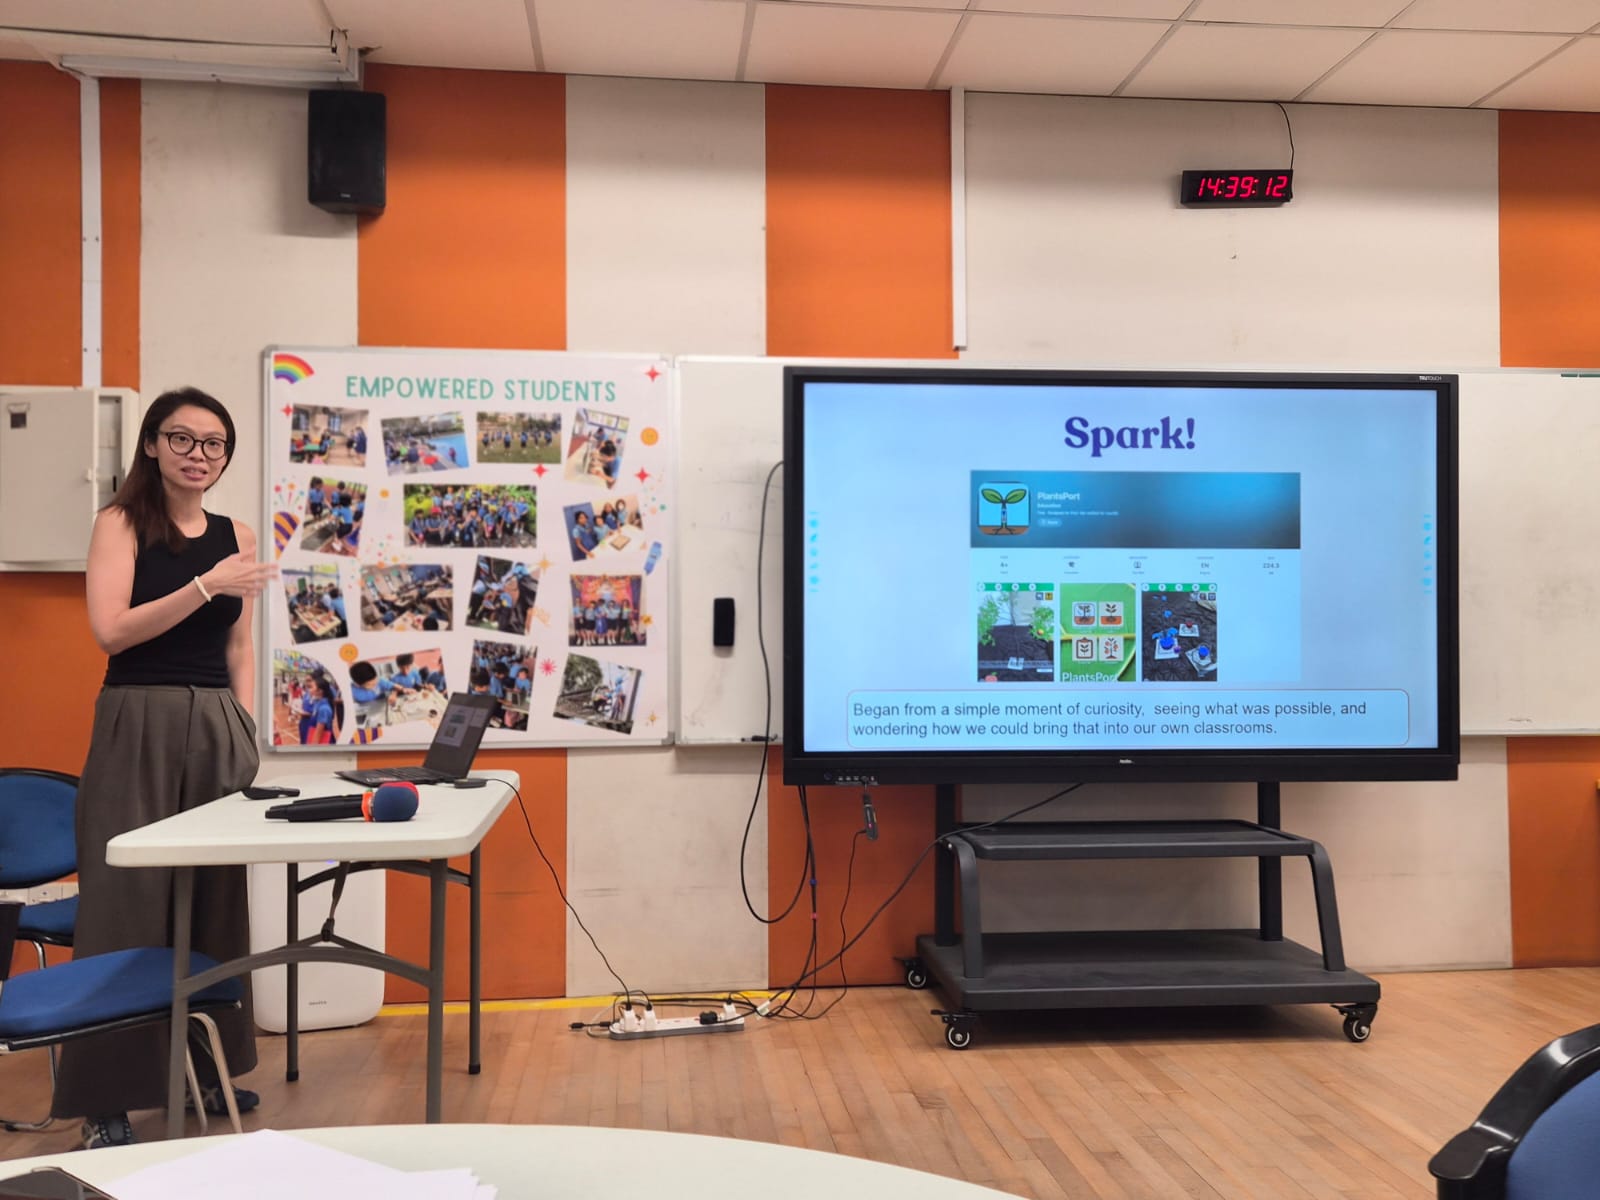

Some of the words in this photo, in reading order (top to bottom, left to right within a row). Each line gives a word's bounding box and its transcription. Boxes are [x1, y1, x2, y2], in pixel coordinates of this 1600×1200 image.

[345, 375, 494, 400] EMPOWERED
[504, 378, 616, 402] STUDENTS
[1064, 415, 1196, 458] Spark!
[1037, 491, 1080, 501] PlantsPort
[853, 703, 900, 719] Began
[904, 703, 936, 716] from
[941, 706, 950, 716] a
[954, 702, 1000, 718] simple
[1005, 703, 1062, 716] moment
[1066, 702, 1081, 716] of
[1084, 702, 1145, 718] curiosity,
[1154, 702, 1200, 718] seeing
[1205, 702, 1238, 715] what
[1242, 705, 1270, 715] was
[1275, 701, 1336, 718] possible,
[1340, 702, 1367, 715] and
[853, 722, 928, 738] wondering
[932, 722, 962, 735] how
[965, 725, 987, 736] we
[990, 722, 1029, 735] could
[1033, 721, 1068, 738] bring
[1073, 721, 1100, 735] that
[1104, 721, 1129, 735] into
[1133, 724, 1157, 735] our
[1161, 724, 1190, 735] own
[1193, 721, 1278, 735] classrooms.
